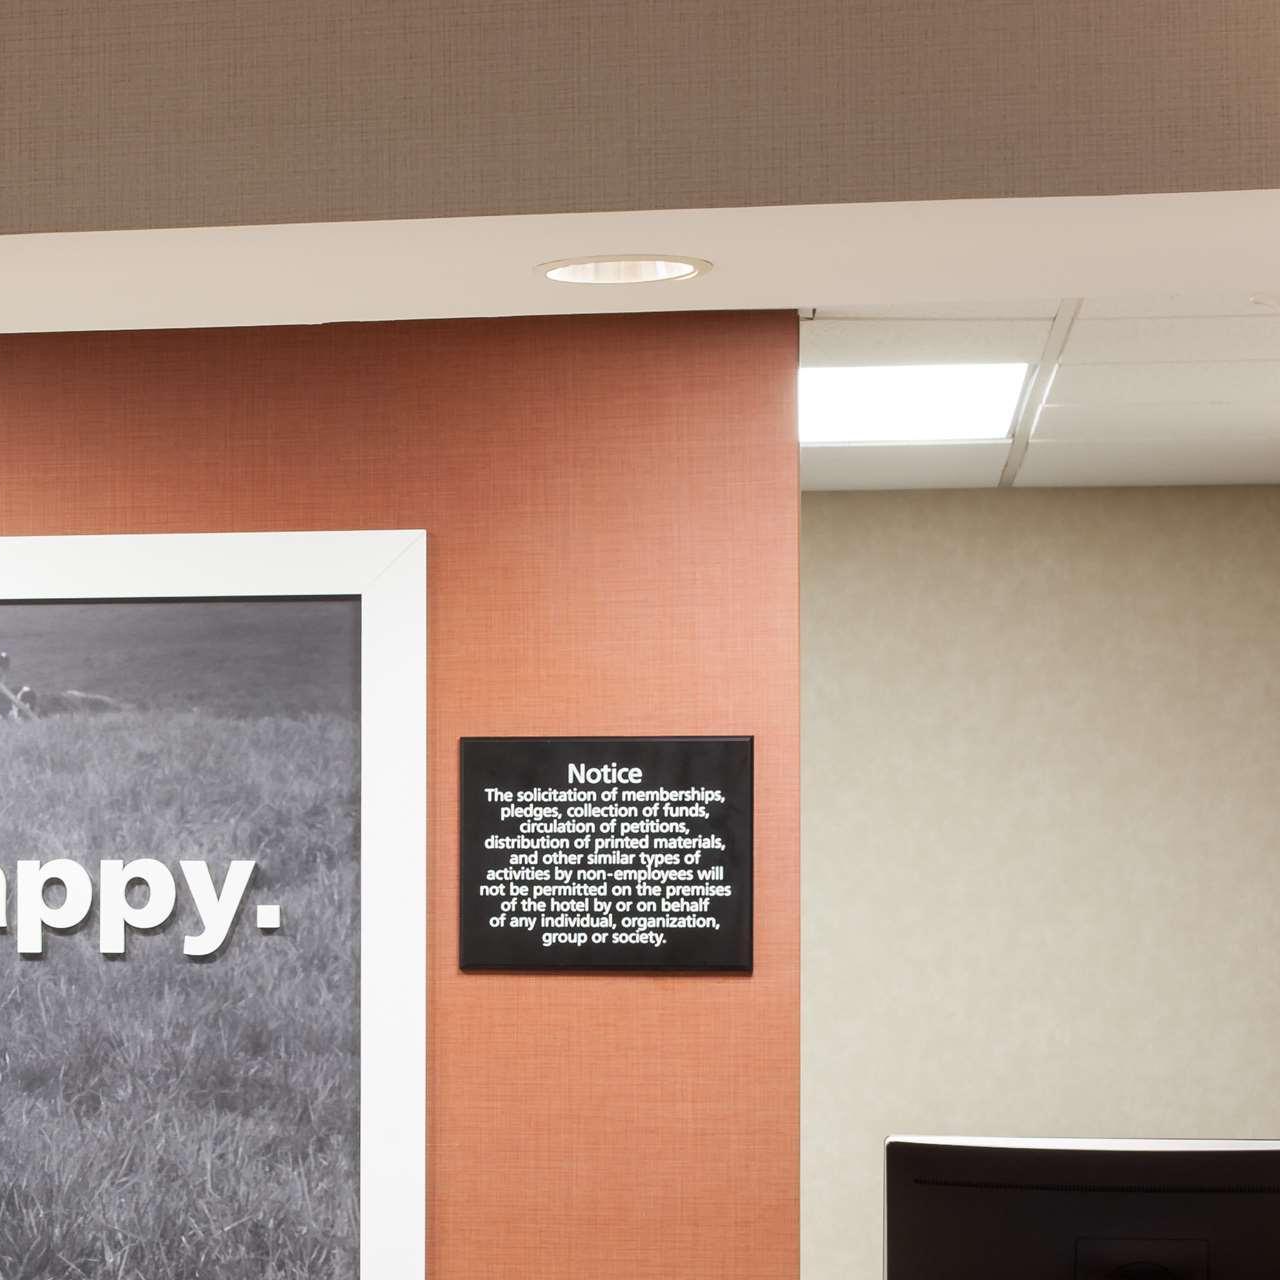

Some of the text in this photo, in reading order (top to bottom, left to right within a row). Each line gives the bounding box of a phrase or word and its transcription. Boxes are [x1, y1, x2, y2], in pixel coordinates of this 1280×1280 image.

[568, 763, 643, 784] Notice
[484, 788, 726, 806] The solicitation of memberships,
[500, 803, 710, 821] pledges, collection of funds,
[519, 819, 690, 837] circulation of petitions,
[484, 835, 726, 853] distribution of printed materials,
[509, 851, 702, 868] and other similar types of
[486, 866, 724, 884] activities by non-employees will
[480, 882, 732, 900] not be permitted on the premises
[500, 897, 710, 916] of the hotel by or on behalf
[489, 913, 720, 931] of any individual, organization,
[542, 929, 667, 947] group or society.
